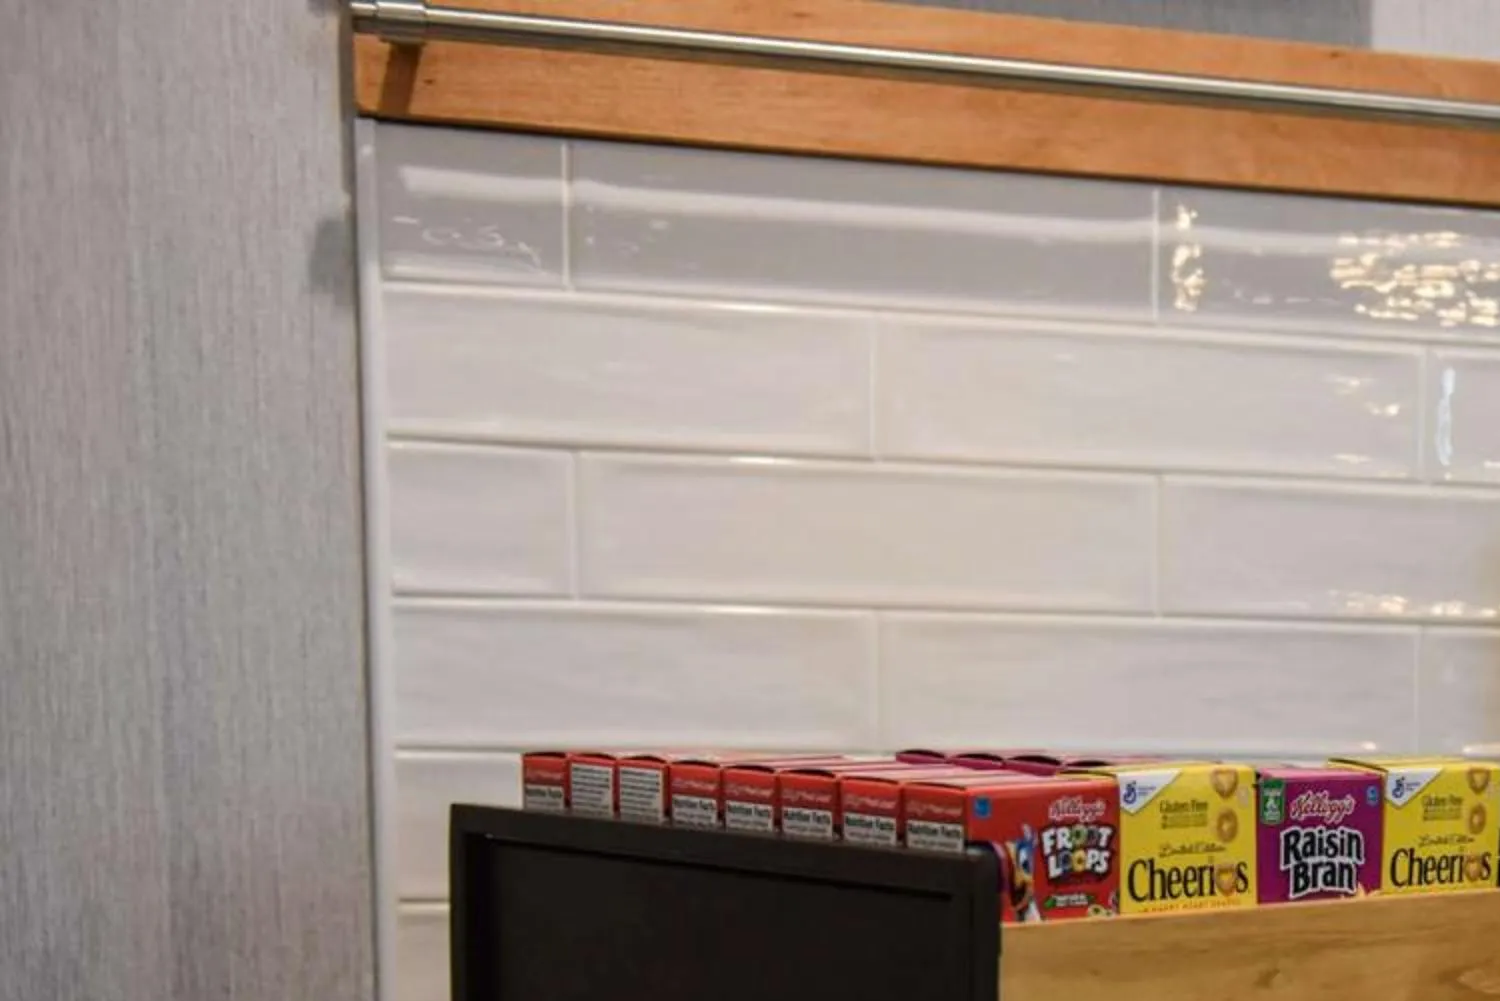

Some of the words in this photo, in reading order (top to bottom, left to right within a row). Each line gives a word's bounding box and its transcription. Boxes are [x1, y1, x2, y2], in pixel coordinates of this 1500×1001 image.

[1290, 790, 1356, 824] Kellogg's
[1042, 824, 1113, 856] FROOT
[1282, 826, 1364, 868] Raisin
[1048, 848, 1111, 879] LOOPS
[1127, 857, 1249, 903] Cheerios
[1291, 859, 1357, 896] Bran
[1390, 847, 1492, 888] Cheerios
